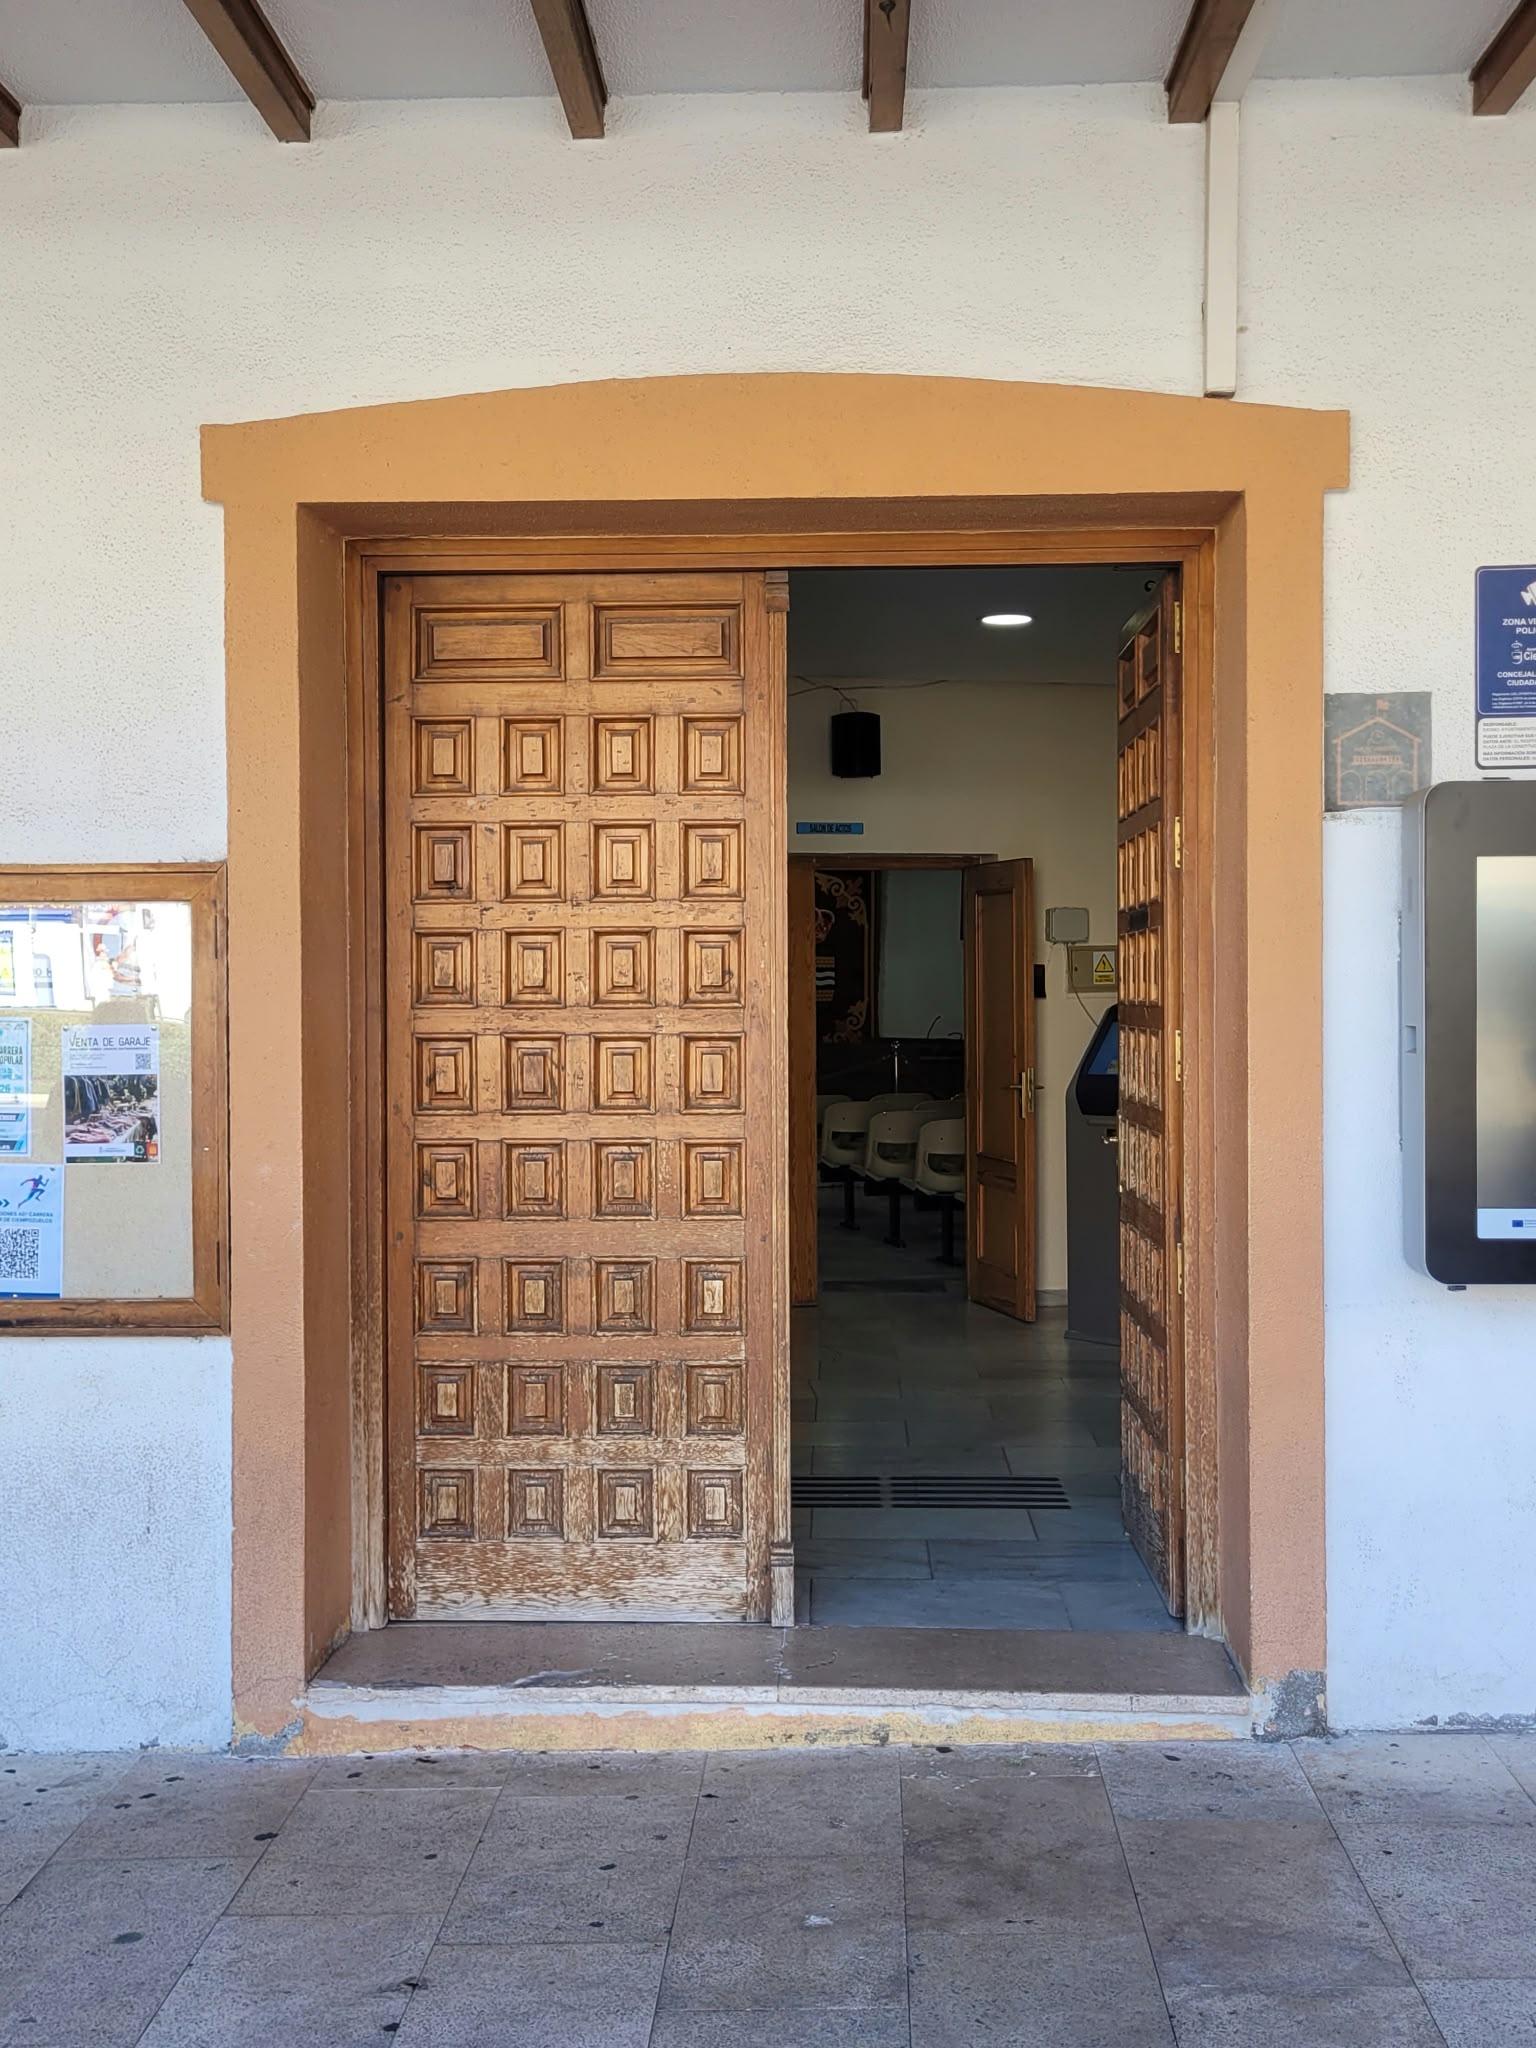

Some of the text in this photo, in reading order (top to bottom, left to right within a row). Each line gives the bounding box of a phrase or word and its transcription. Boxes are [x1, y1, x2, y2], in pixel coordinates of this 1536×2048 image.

[1502, 618, 1526, 626] ZONA
[69, 1032, 151, 1047] VENTA DE GARAJE
